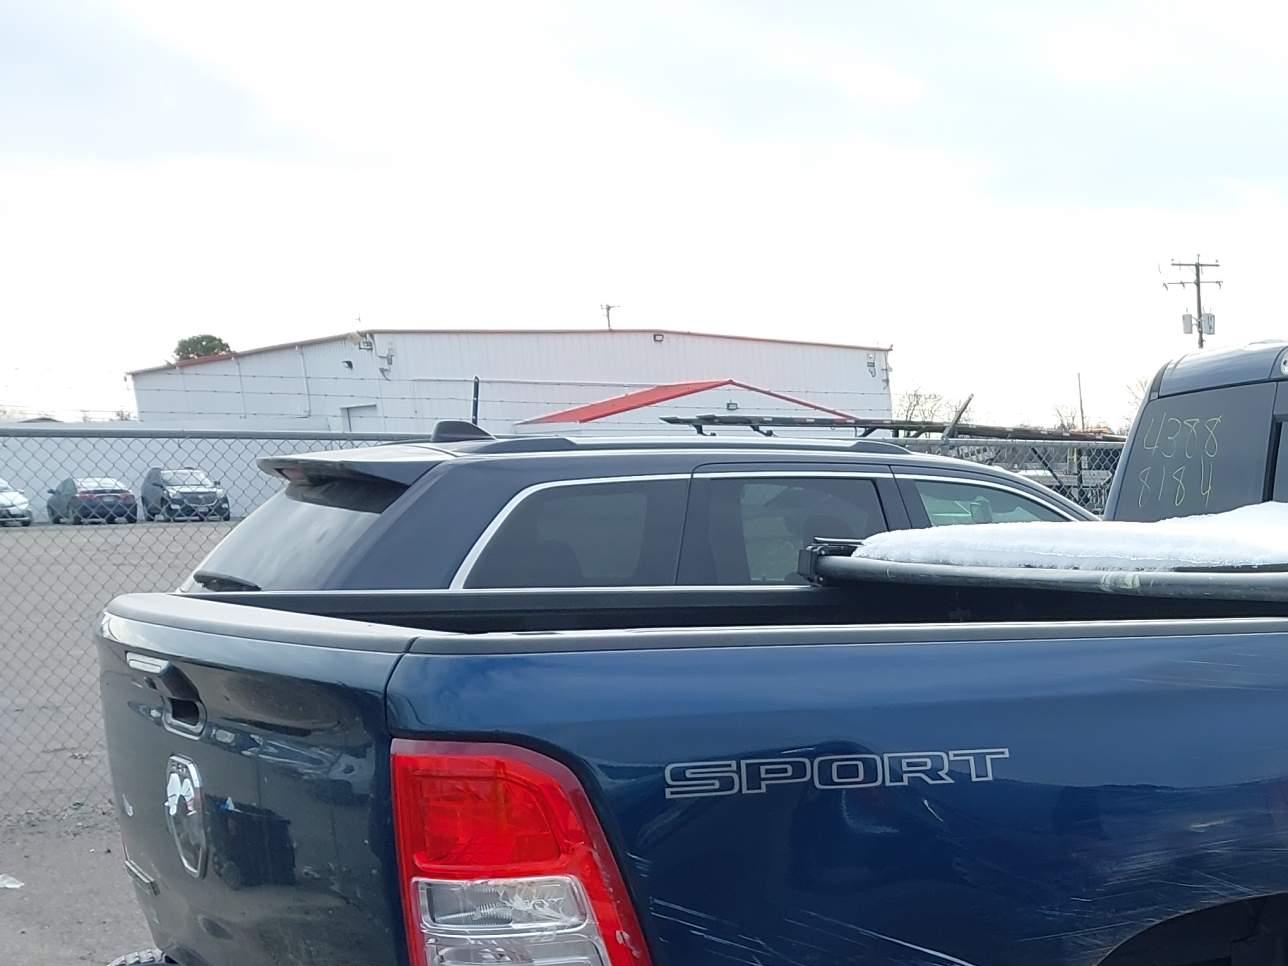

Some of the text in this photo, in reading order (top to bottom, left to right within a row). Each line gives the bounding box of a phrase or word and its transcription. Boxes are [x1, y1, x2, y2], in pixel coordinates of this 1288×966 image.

[1143, 412, 1222, 459] 4388
[1138, 457, 1213, 509] 8184
[664, 748, 1010, 799] SPORT
